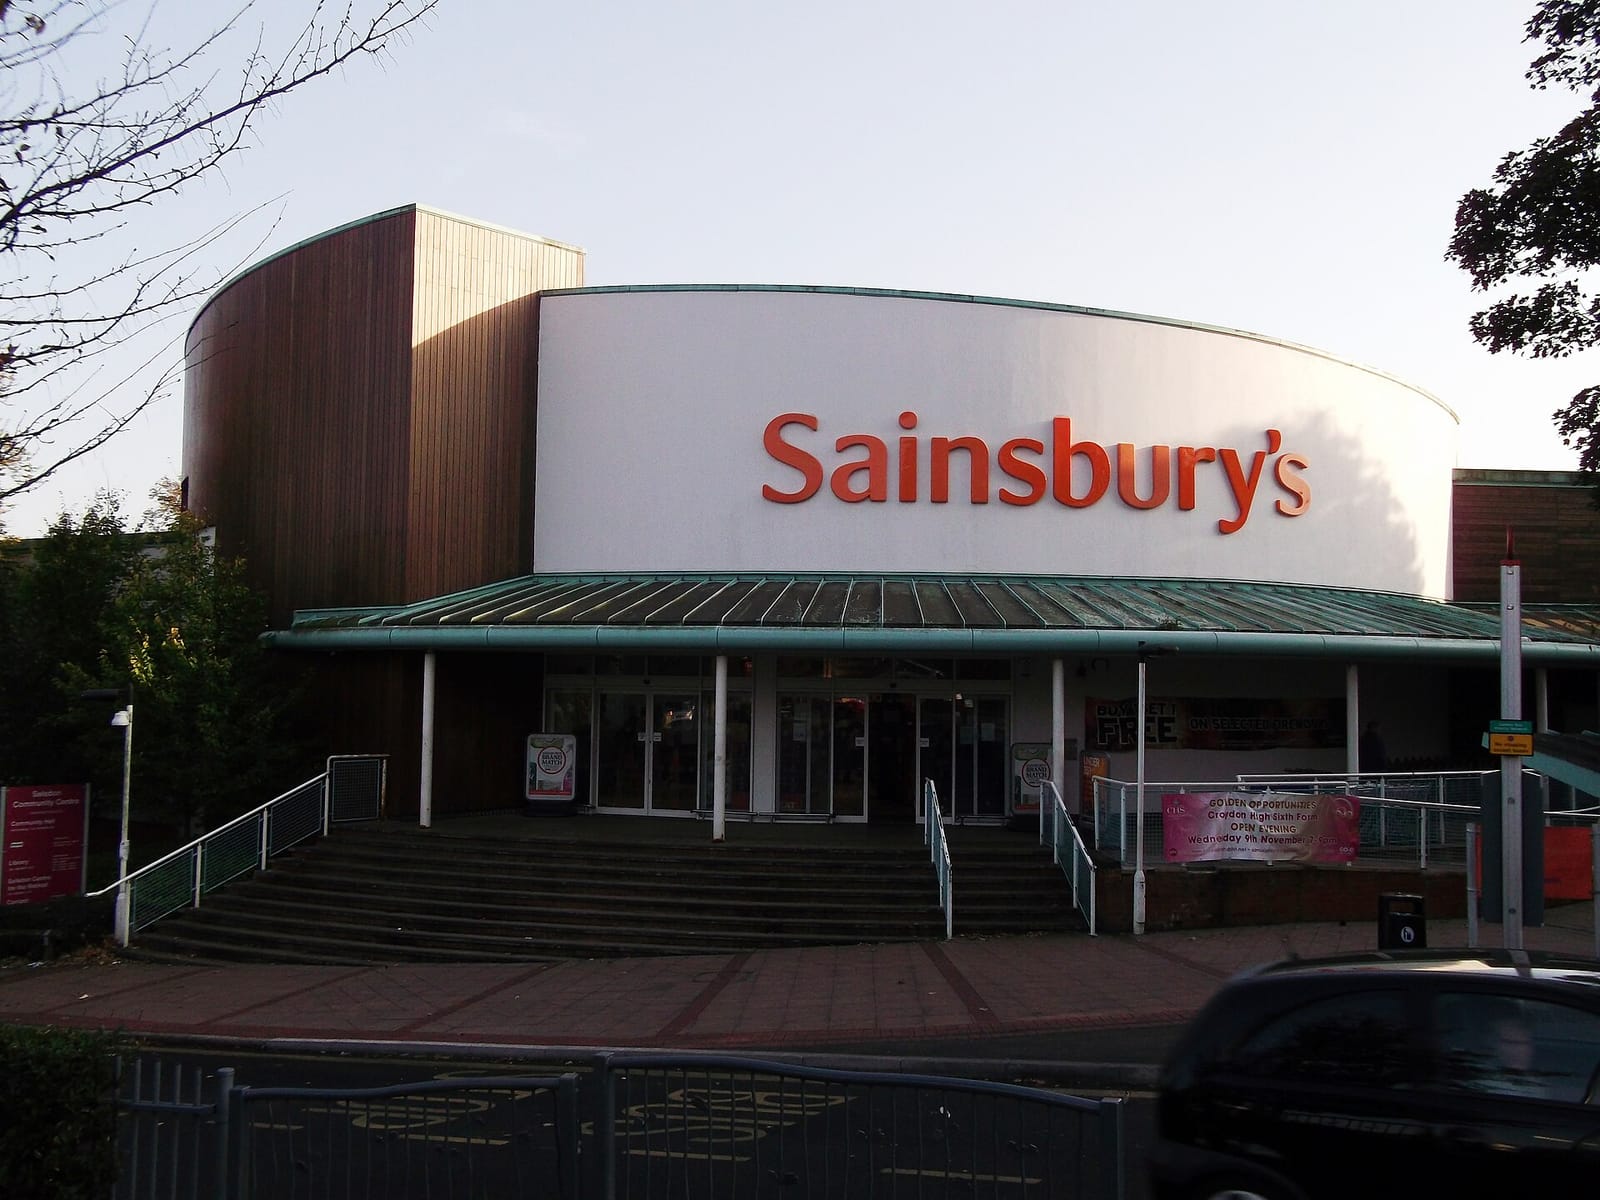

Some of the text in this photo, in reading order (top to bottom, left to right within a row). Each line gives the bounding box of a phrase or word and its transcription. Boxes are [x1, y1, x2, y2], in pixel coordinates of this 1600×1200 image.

[762, 411, 1312, 535] Sainsbury's
[1190, 718, 1208, 730] ON
[1096, 717, 1177, 745] FREE
[1209, 798, 1318, 809] GOLDEN OPPORTUNITIES
[1207, 811, 1318, 822] Croydon High Sixth Form
[1230, 822, 1297, 833] OPEN EVENING
[1188, 833, 1242, 844] Wedneday
[1260, 835, 1305, 844] November
